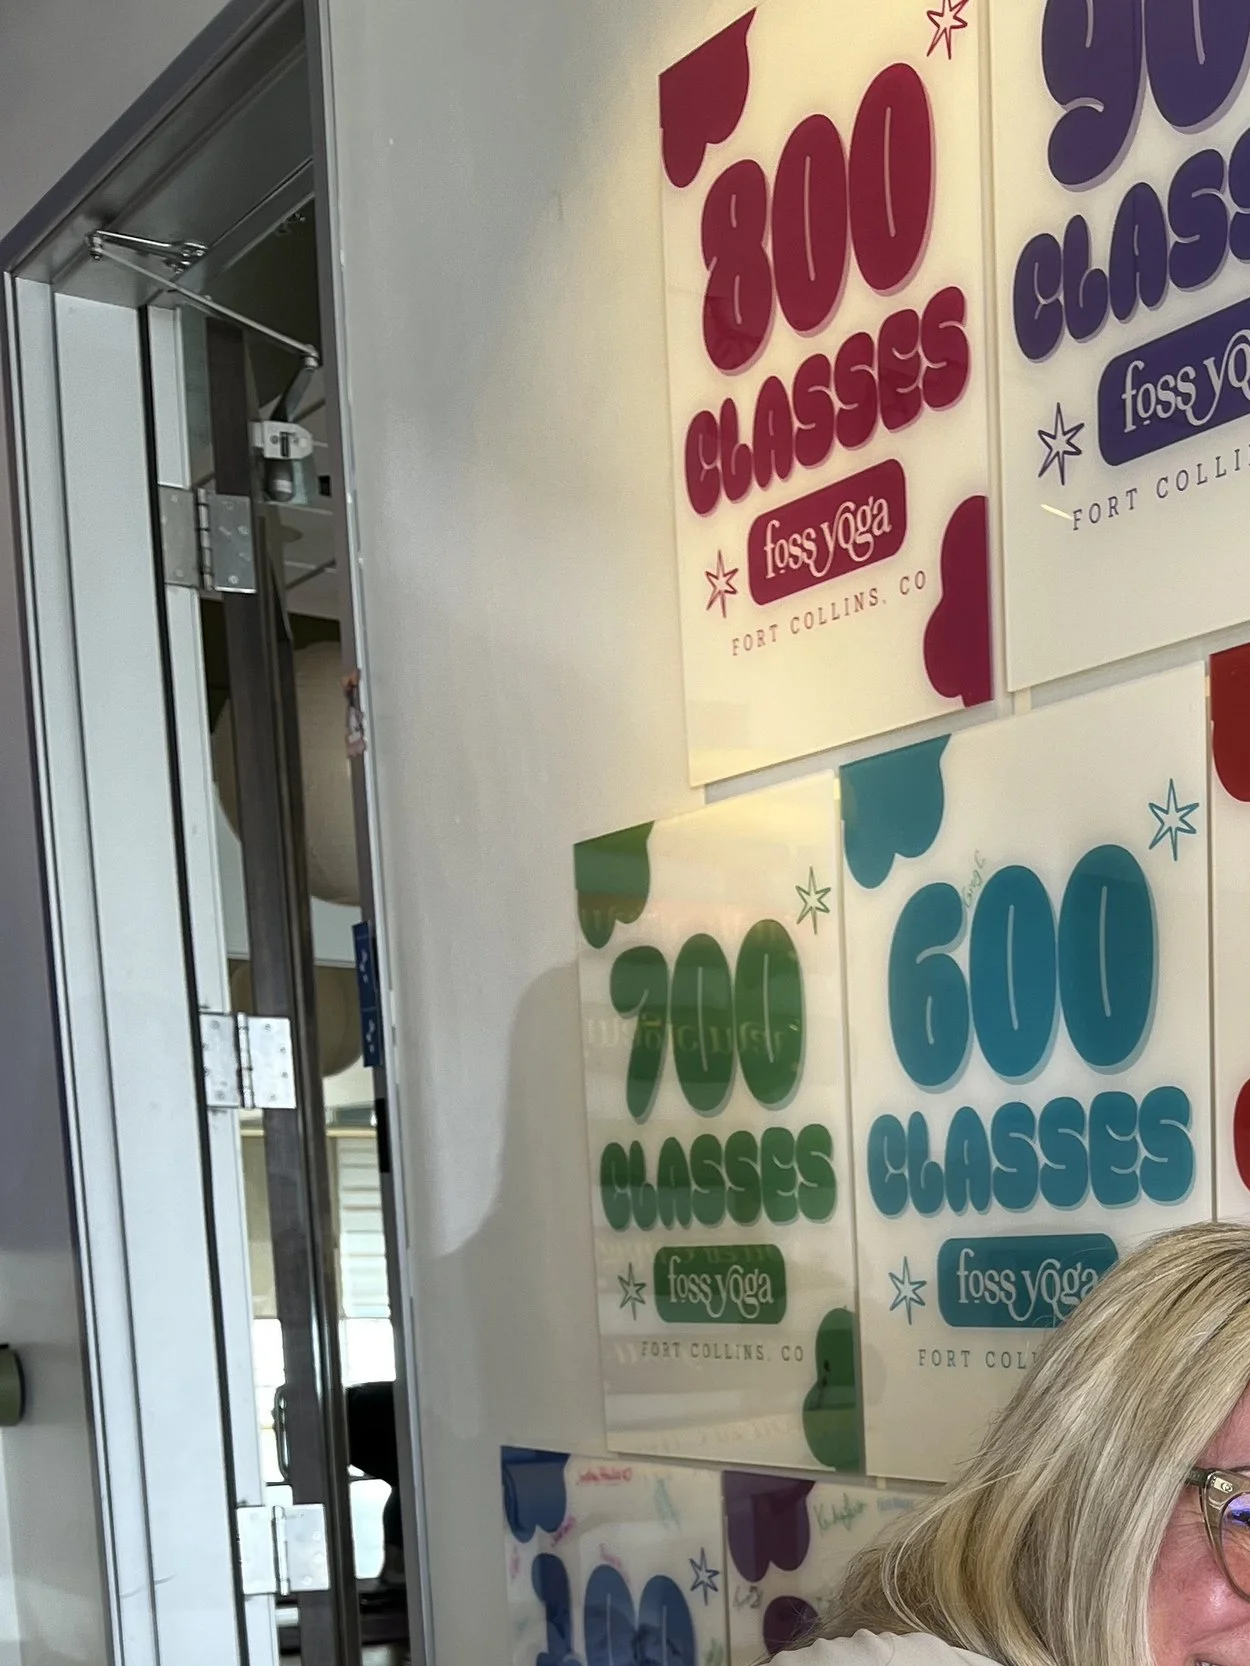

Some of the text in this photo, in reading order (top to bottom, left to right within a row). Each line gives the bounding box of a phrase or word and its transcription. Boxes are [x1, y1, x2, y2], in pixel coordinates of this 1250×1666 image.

[700, 62, 936, 376] 800
[684, 286, 970, 516] CLASSES
[1121, 360, 1197, 433] foss
[763, 496, 892, 579] foss yoga
[1072, 488, 1138, 531] FORT
[732, 624, 778, 656] FORT
[900, 570, 926, 595] CO
[888, 844, 1160, 1094] 600
[609, 919, 806, 1123] 700
[600, 1123, 838, 1231] CLASSES
[867, 1085, 1195, 1219] CLASSES
[667, 1255, 774, 1318] foss yoga
[956, 1248, 1016, 1304] foss
[641, 1341, 680, 1358] FORT
[781, 1345, 804, 1362] CO
[918, 1349, 970, 1368] FORT
